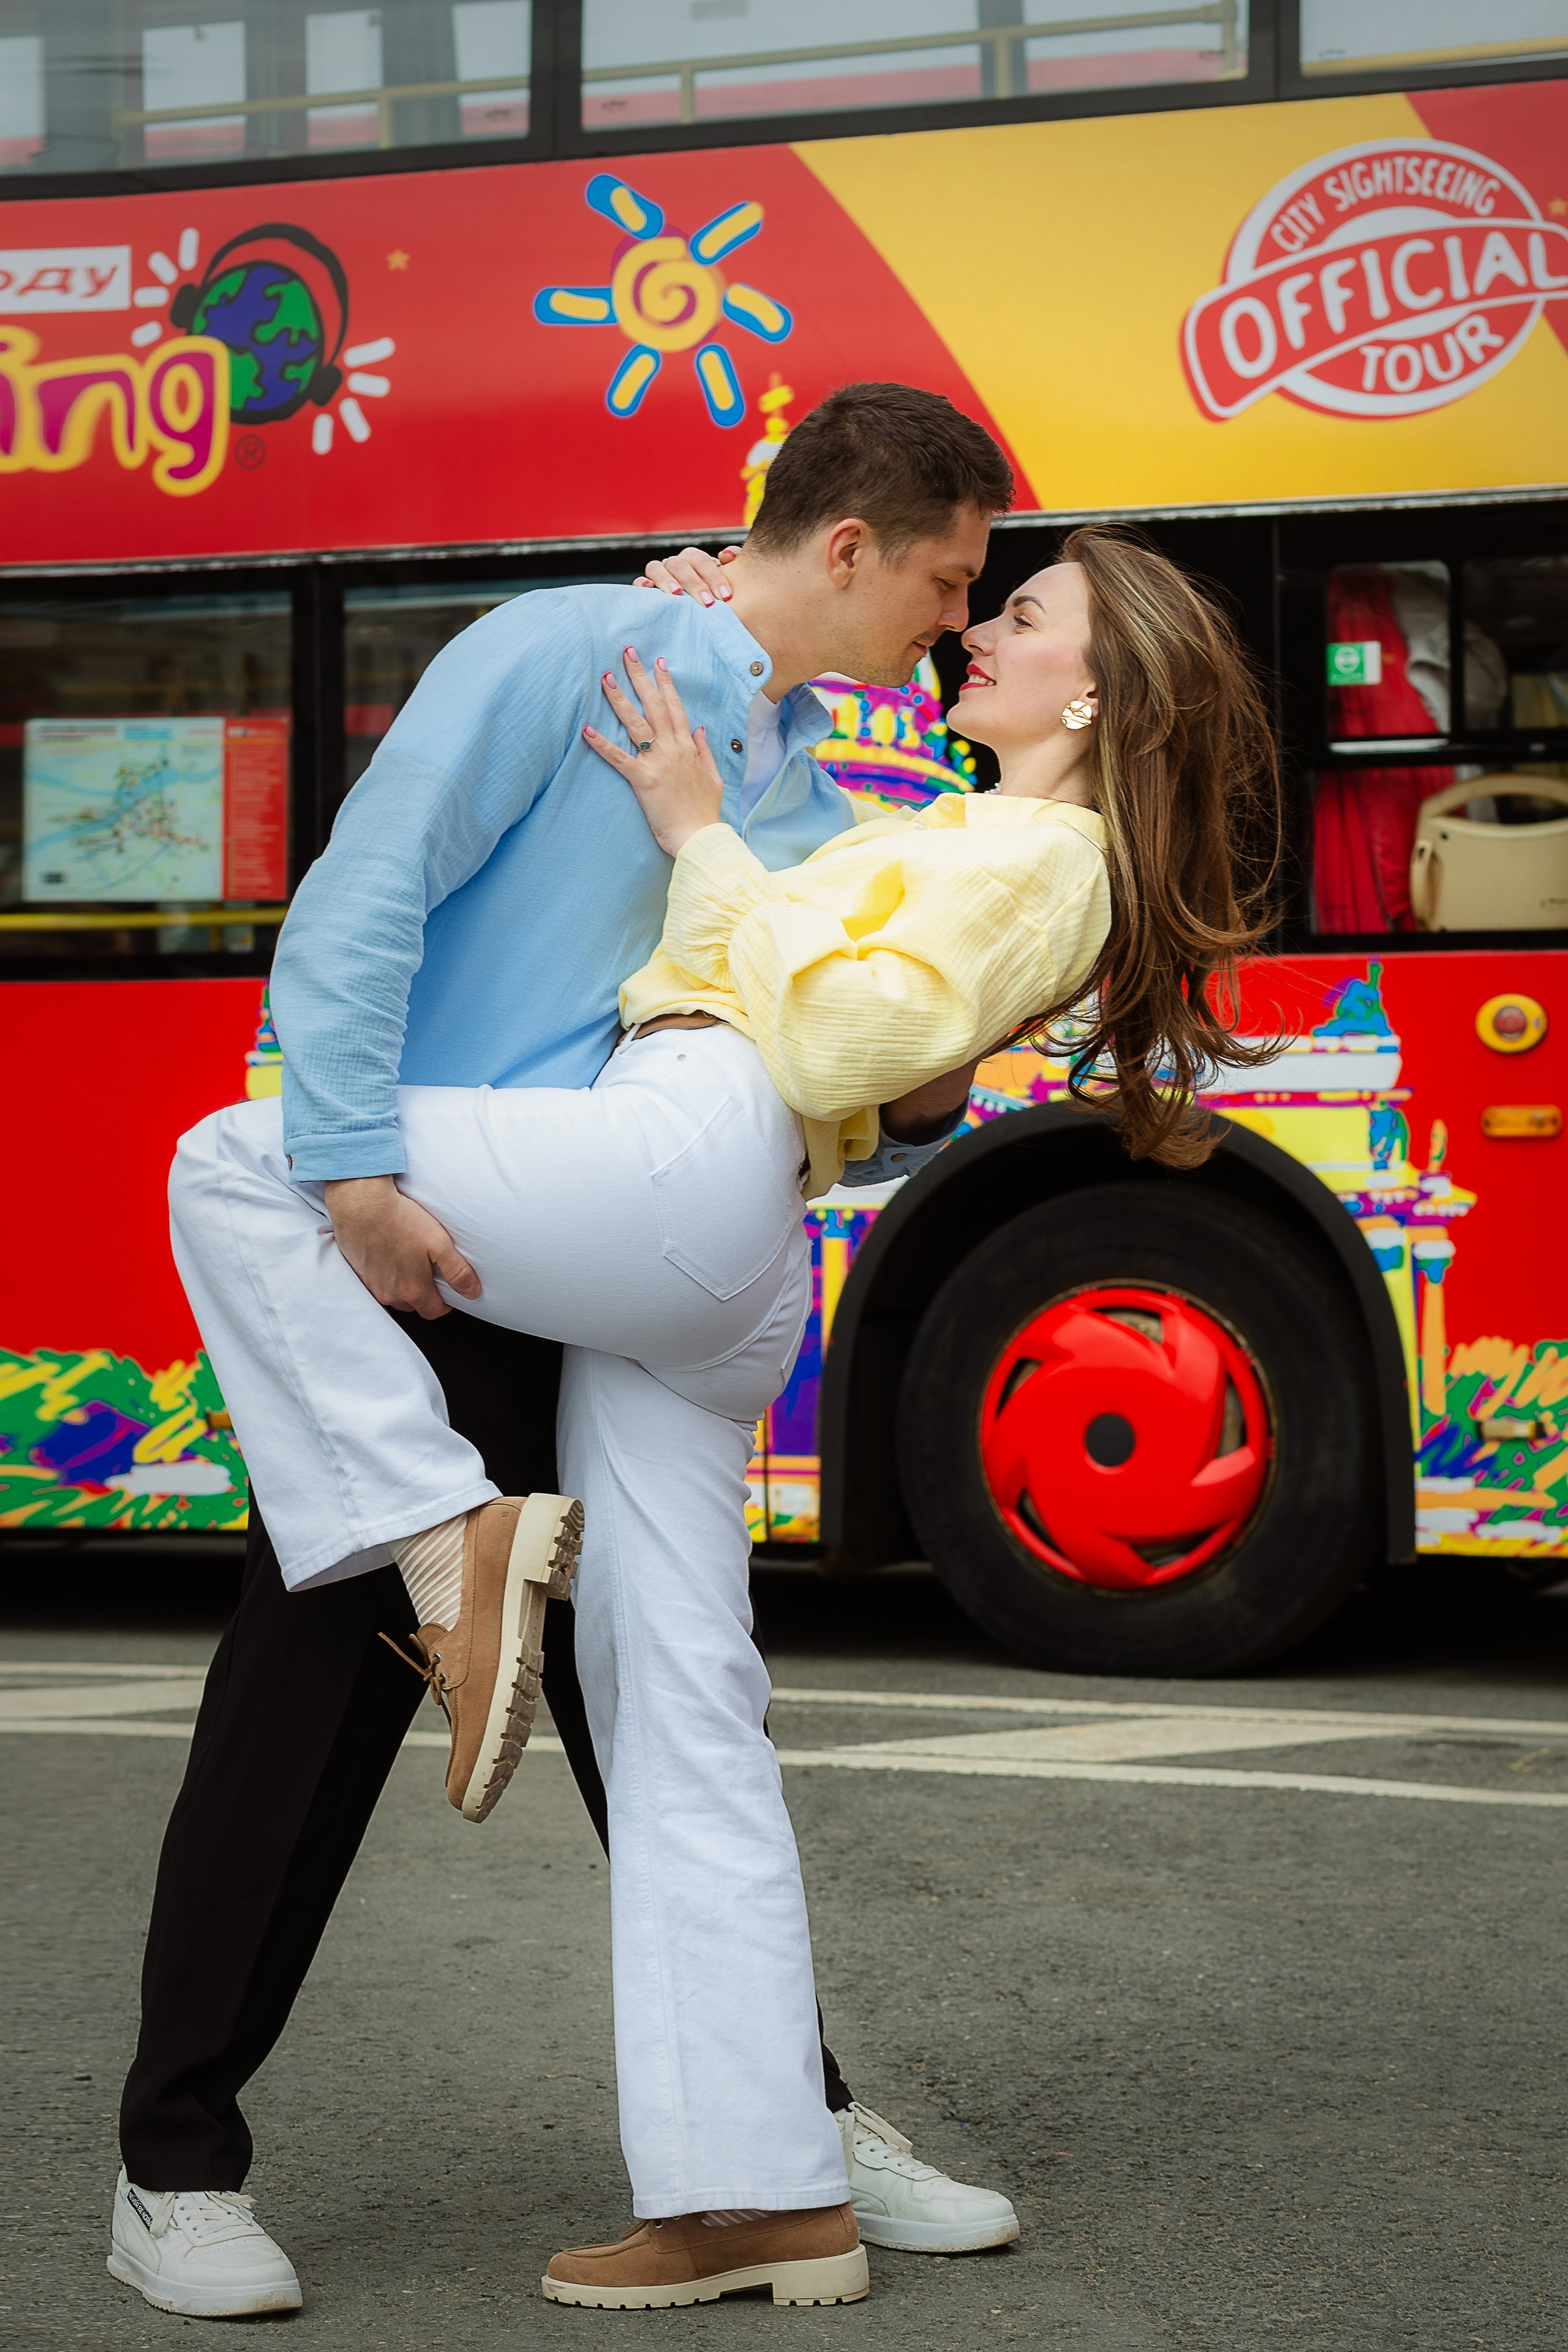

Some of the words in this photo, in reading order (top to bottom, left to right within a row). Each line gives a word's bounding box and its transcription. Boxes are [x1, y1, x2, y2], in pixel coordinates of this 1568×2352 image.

[1270, 193, 1325, 253] CITY
[1324, 157, 1499, 216] SIGHTSEEING
[1219, 230, 1568, 379] OFFICIAL
[1359, 314, 1504, 392] TOUR
